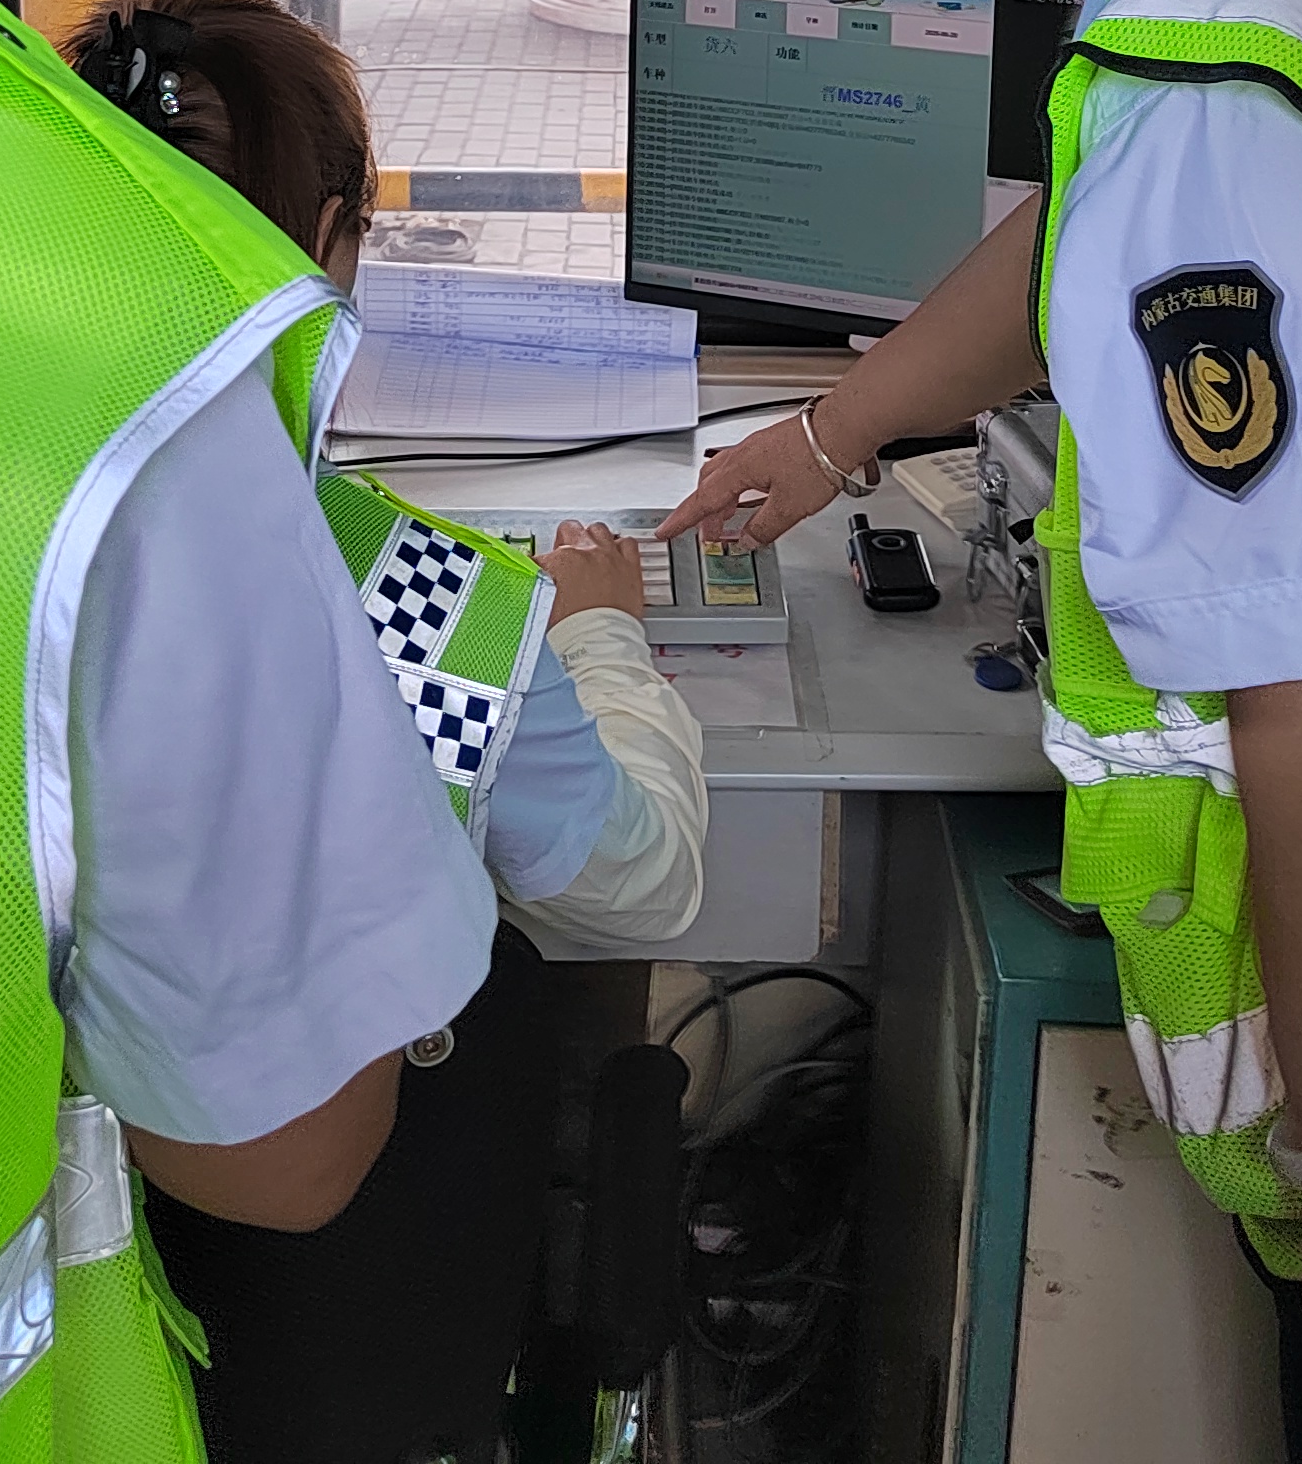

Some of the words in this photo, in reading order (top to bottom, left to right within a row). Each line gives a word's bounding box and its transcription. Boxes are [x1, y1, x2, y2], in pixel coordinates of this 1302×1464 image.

[644, 31, 667, 46] 车型
[775, 46, 801, 60] 功能
[643, 67, 666, 81] 车种
[1141, 284, 1258, 331] 内蒙古交通集团
